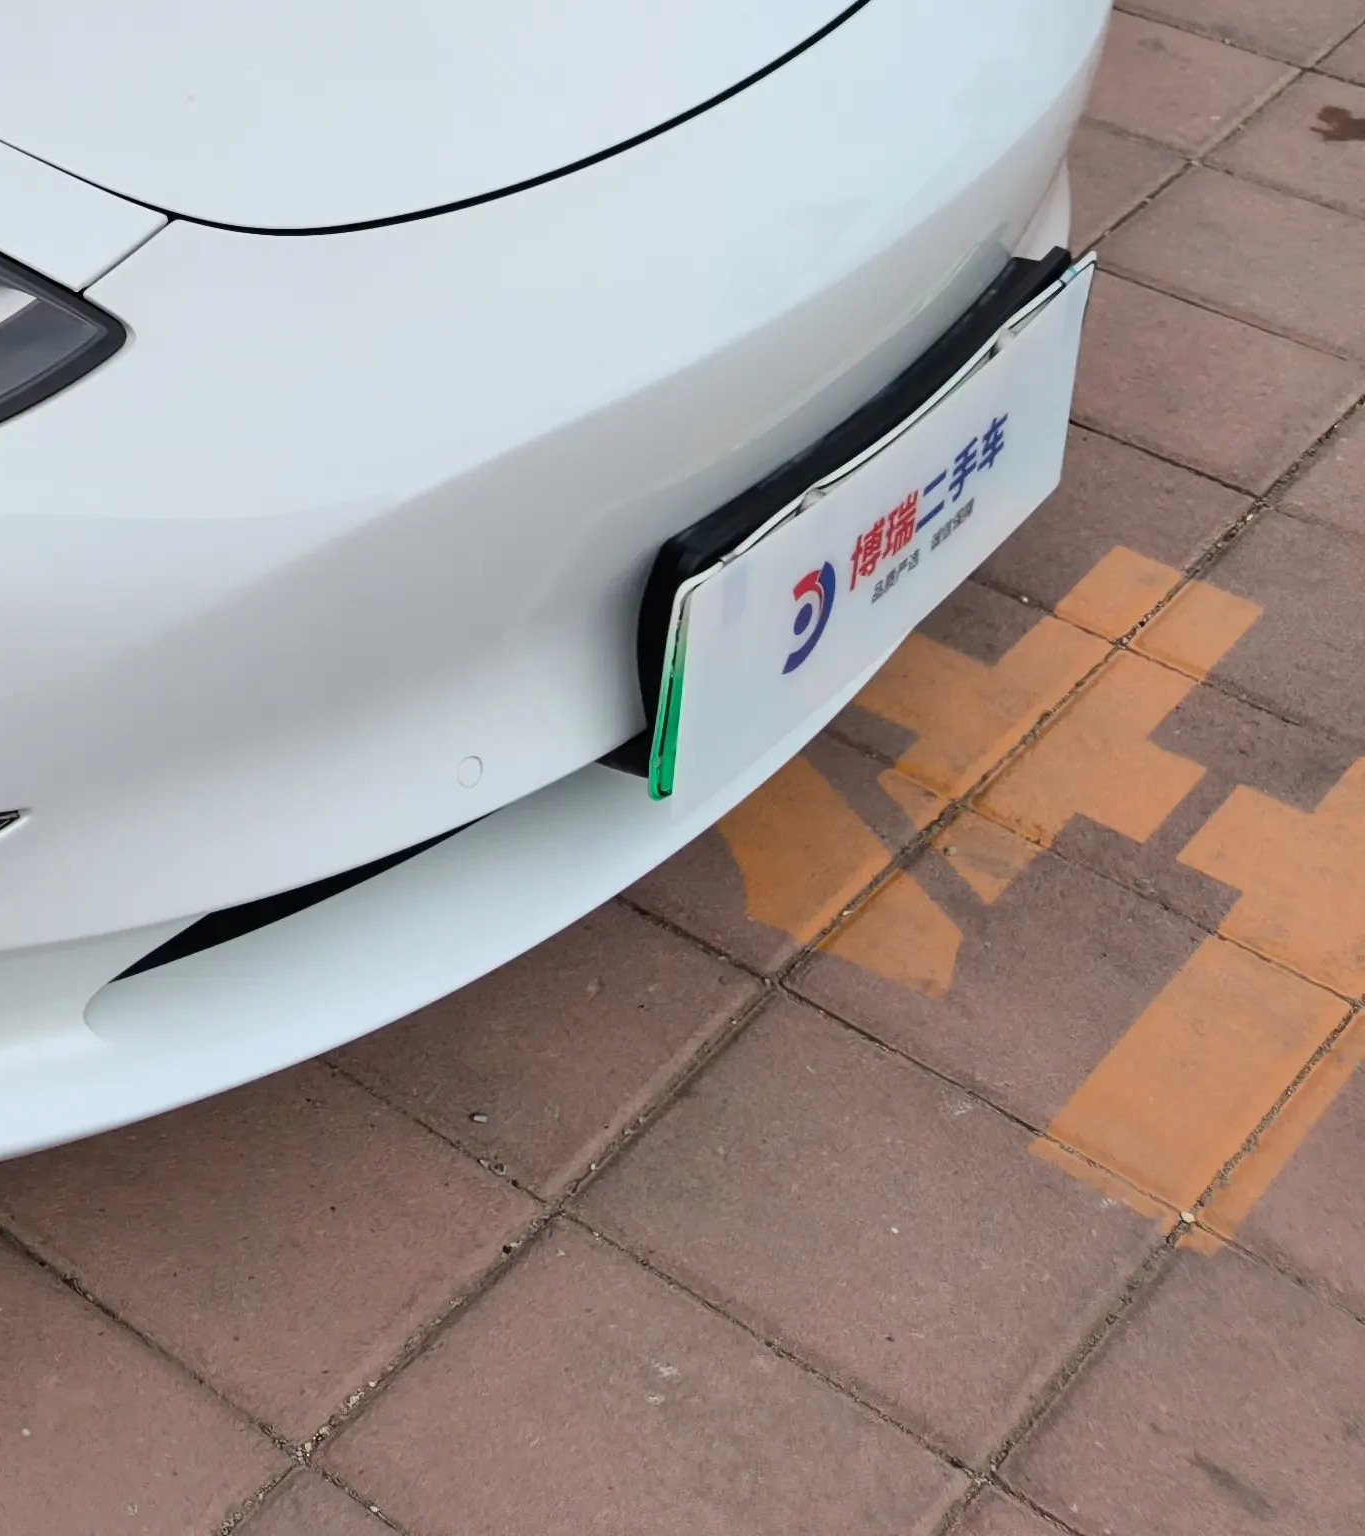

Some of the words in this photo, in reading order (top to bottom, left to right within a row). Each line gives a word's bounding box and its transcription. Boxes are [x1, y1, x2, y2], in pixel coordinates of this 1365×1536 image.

[850, 413, 1009, 592] 博瑞二手车
